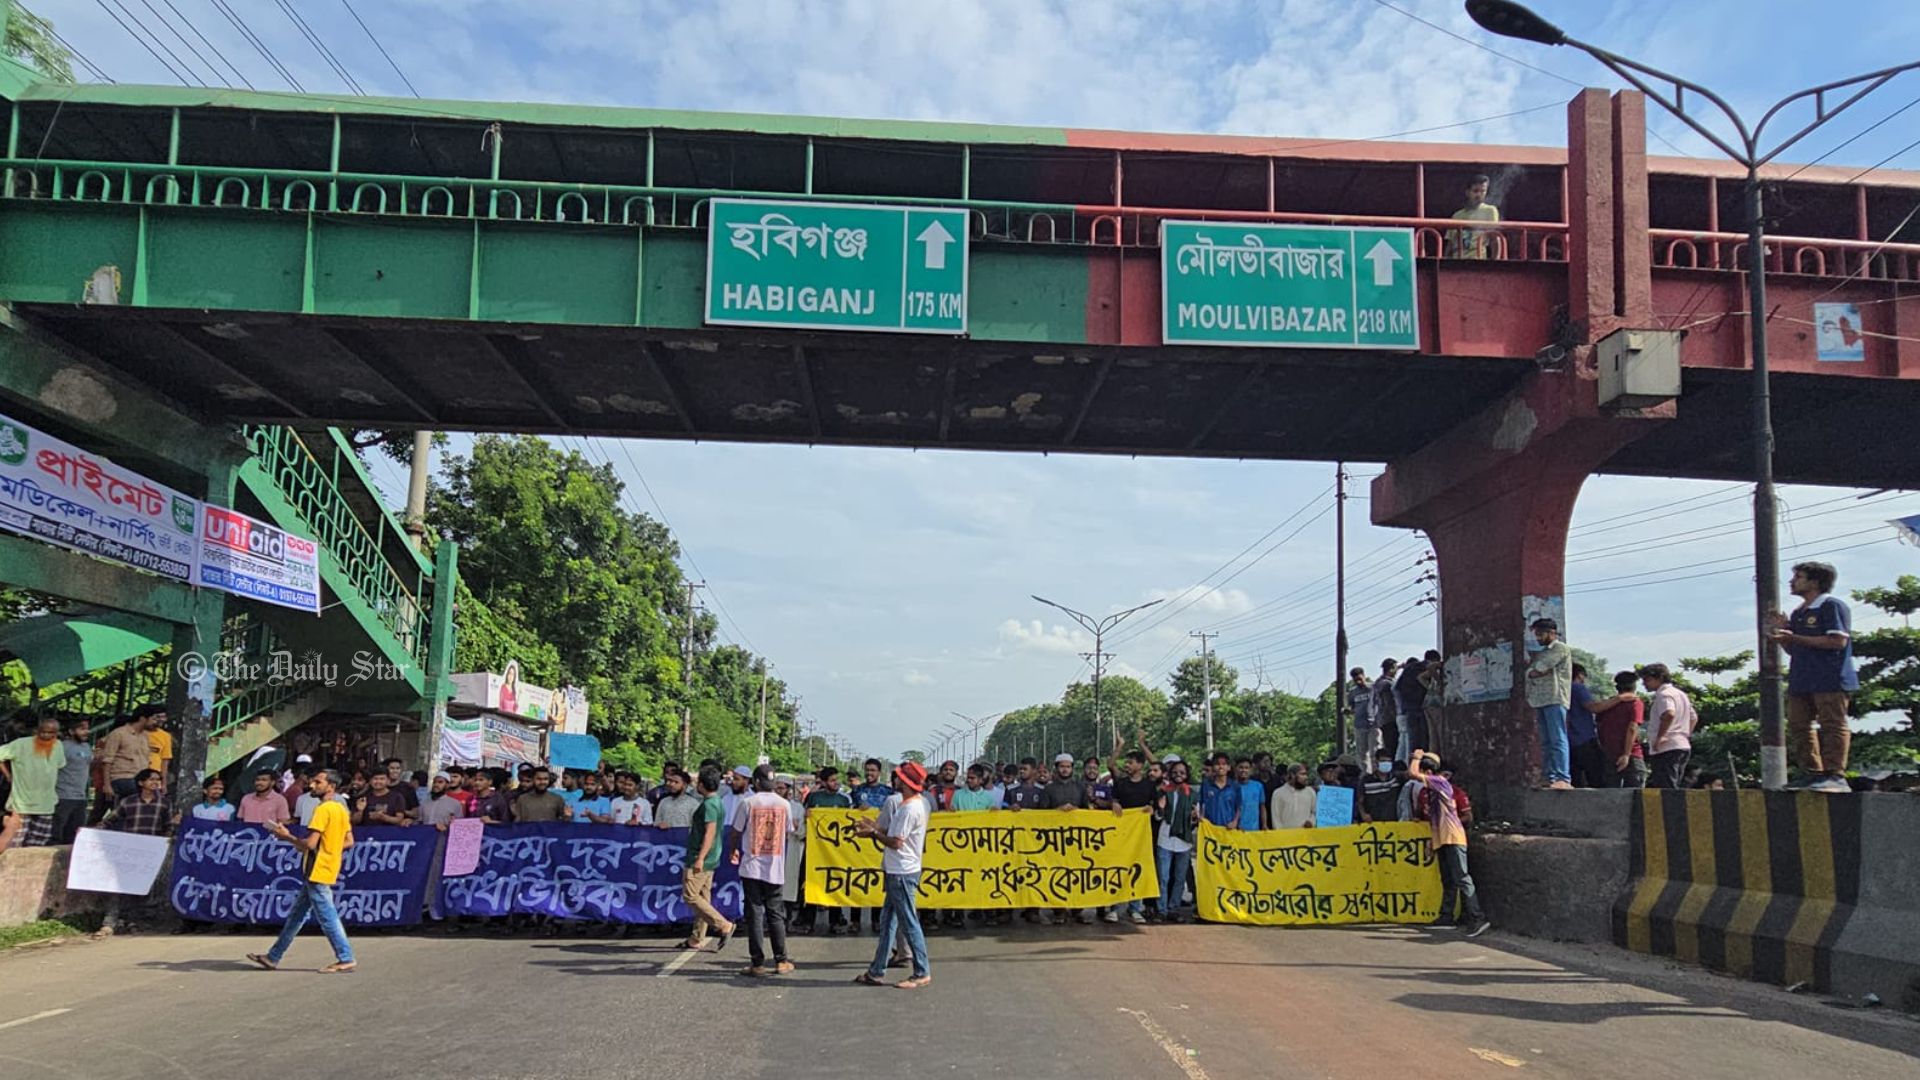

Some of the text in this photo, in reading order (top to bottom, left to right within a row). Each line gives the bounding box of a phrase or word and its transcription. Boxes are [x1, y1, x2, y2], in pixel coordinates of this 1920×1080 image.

[725, 213, 869, 261] হবিগঞ্জ
[1176, 233, 1345, 280] মৌলভীবাজার
[722, 283, 876, 315] HABIGANJ
[908, 290, 962, 319] 175 KM
[1178, 302, 1347, 333] MOULVIBAZAR
[1359, 309, 1412, 335] 218 KM
[36, 449, 167, 517] প্রাইমেট
[206, 514, 285, 561] uniaid
[179, 827, 303, 874] মেধাবীদের
[940, 826, 1025, 854] তোমার
[1017, 826, 1116, 856] আমার
[1258, 843, 1341, 873] লোকের
[443, 865, 637, 917] মেধাভিত্তিক
[1217, 877, 1335, 919] কোটাধারীর
